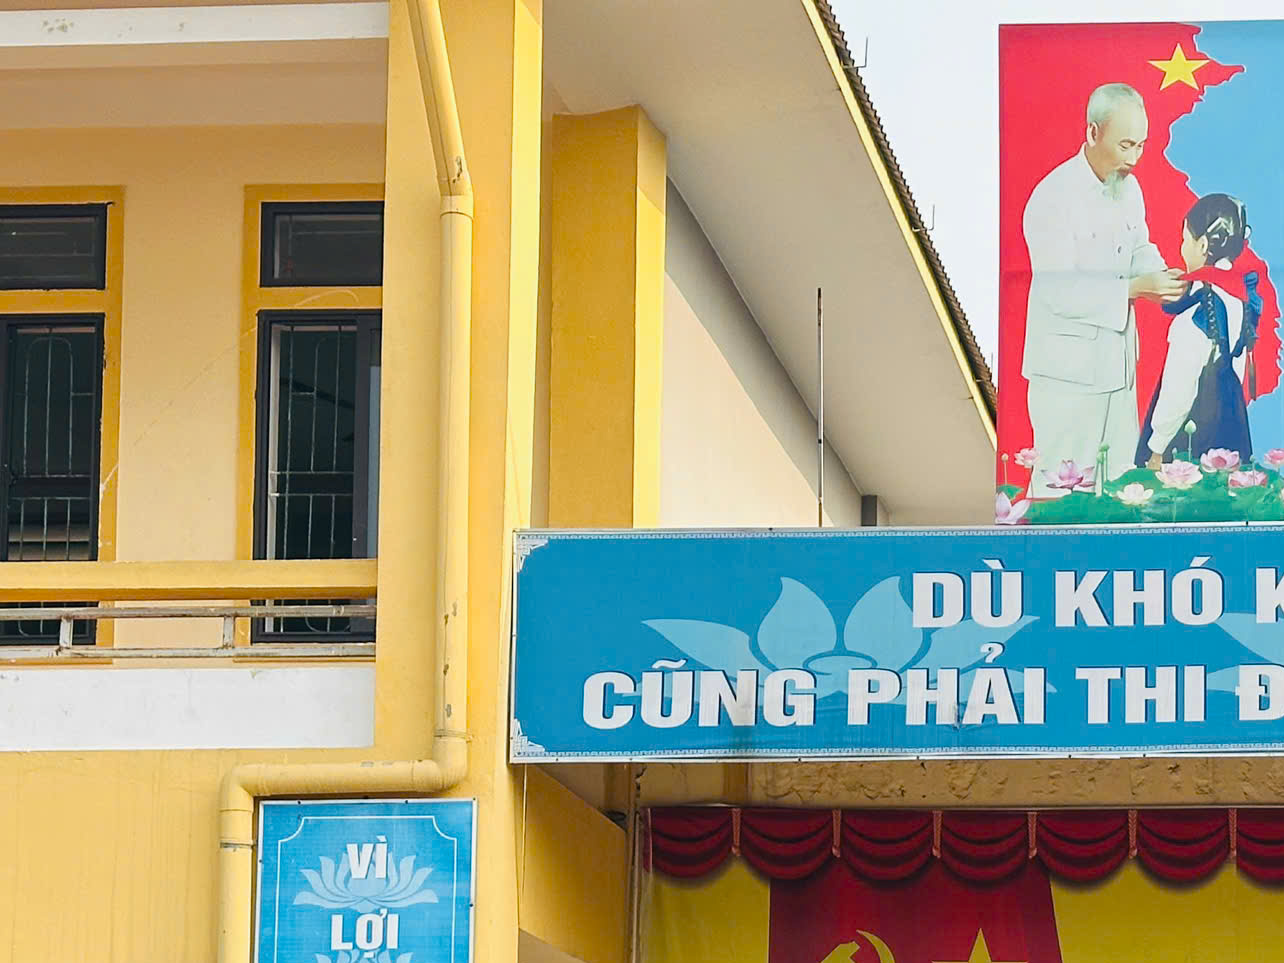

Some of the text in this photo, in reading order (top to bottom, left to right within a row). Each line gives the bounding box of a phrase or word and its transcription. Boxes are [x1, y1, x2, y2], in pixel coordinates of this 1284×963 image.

[912, 558, 1026, 630] DÙ
[1055, 556, 1226, 627] KHÓ
[582, 659, 817, 729] CŨNG
[847, 642, 1047, 727] PHẢI
[1075, 664, 1206, 724] THI
[347, 835, 388, 879] VÌ
[331, 909, 399, 958] LỢI
